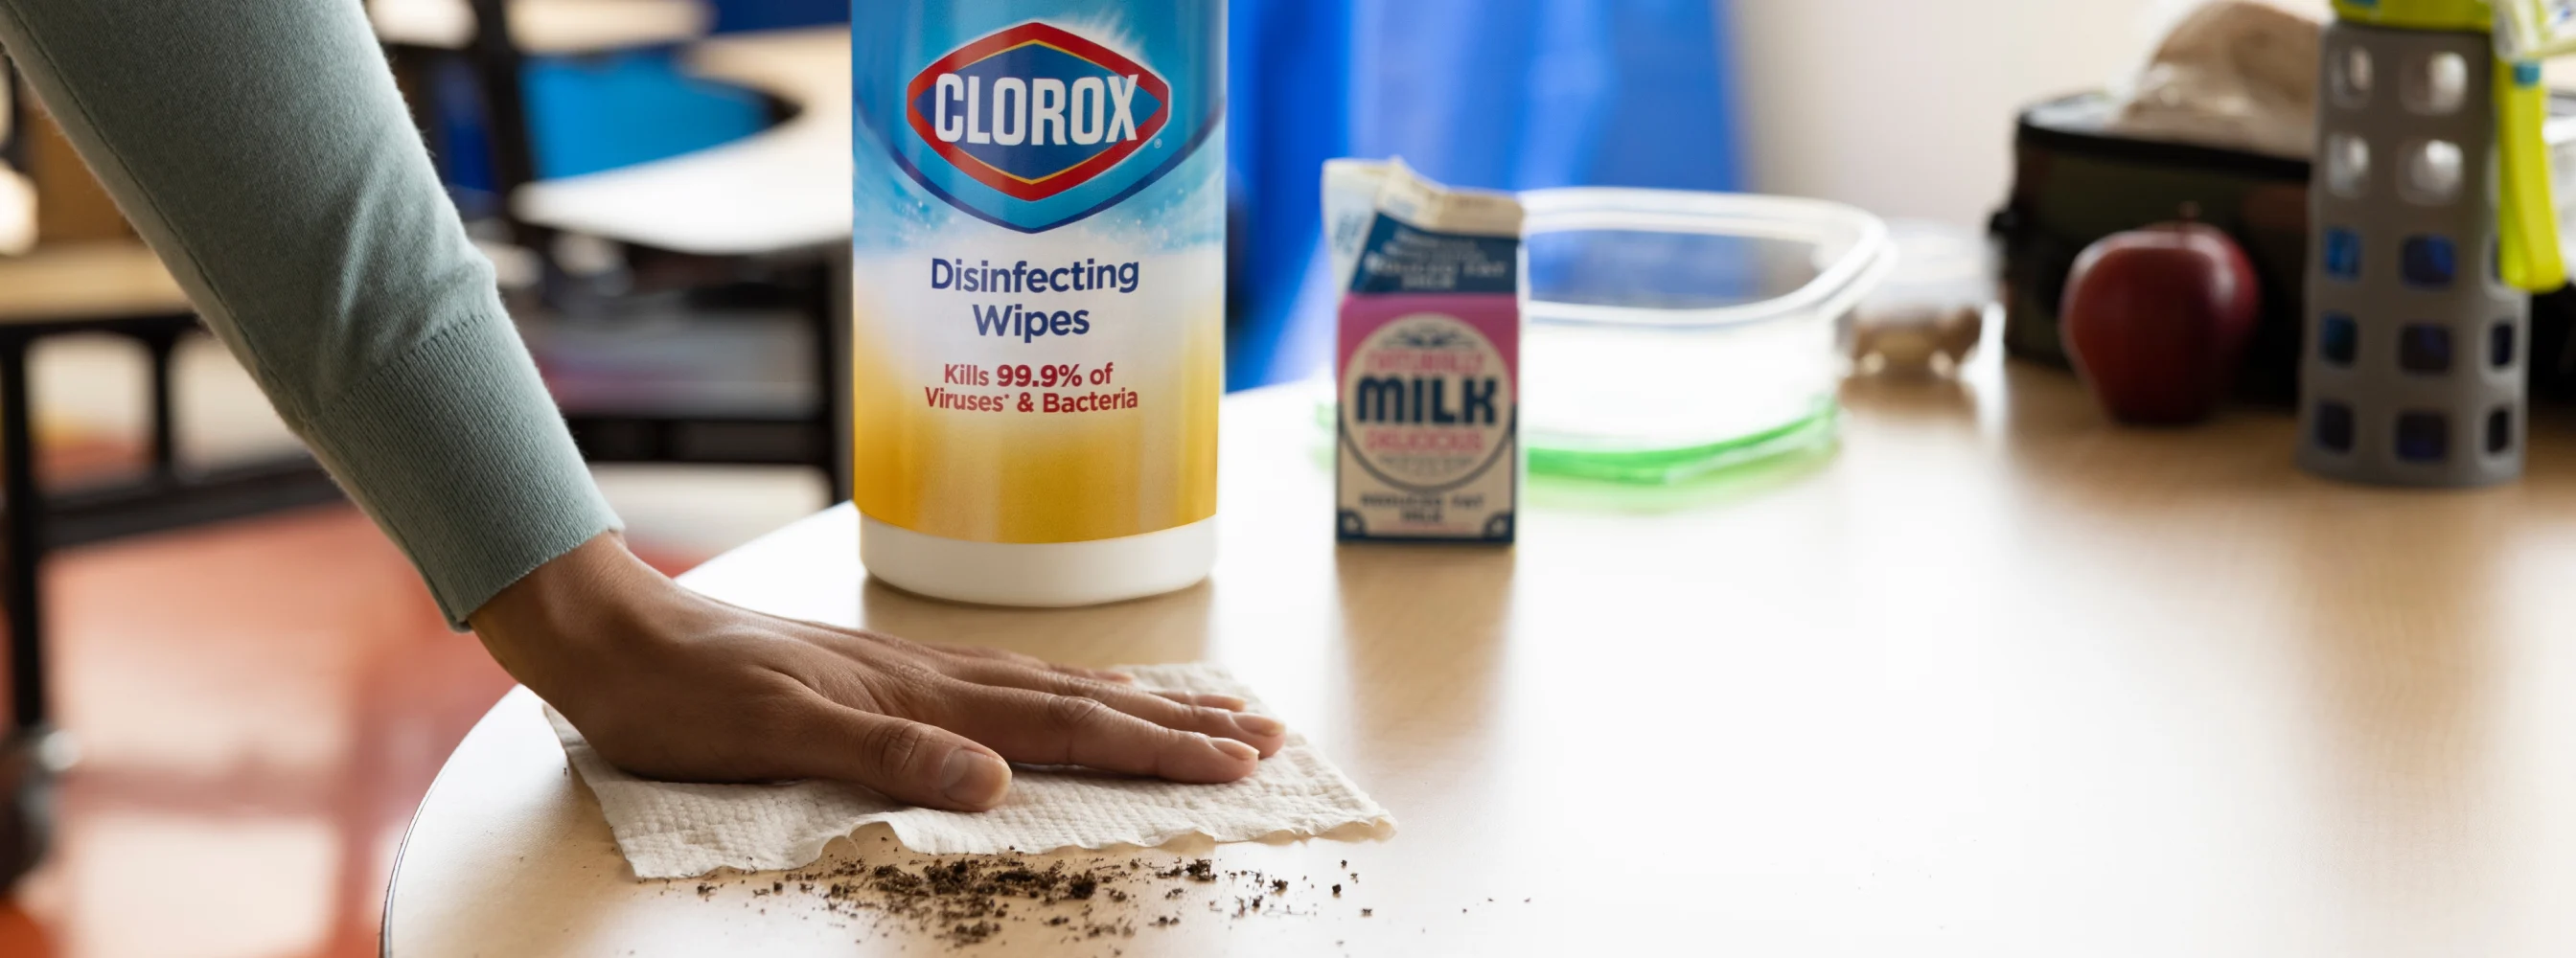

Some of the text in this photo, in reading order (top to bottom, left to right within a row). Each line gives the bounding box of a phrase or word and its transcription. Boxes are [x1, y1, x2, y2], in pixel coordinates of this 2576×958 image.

[934, 73, 1138, 146] CLOROX
[932, 258, 1139, 293] Disinfecting
[972, 304, 1091, 343] Wipes
[944, 362, 1114, 387] Kills 99.9% of
[1016, 392, 1035, 413] &
[1043, 387, 1138, 413] Bacteria
[1356, 375, 1498, 424] MILK
